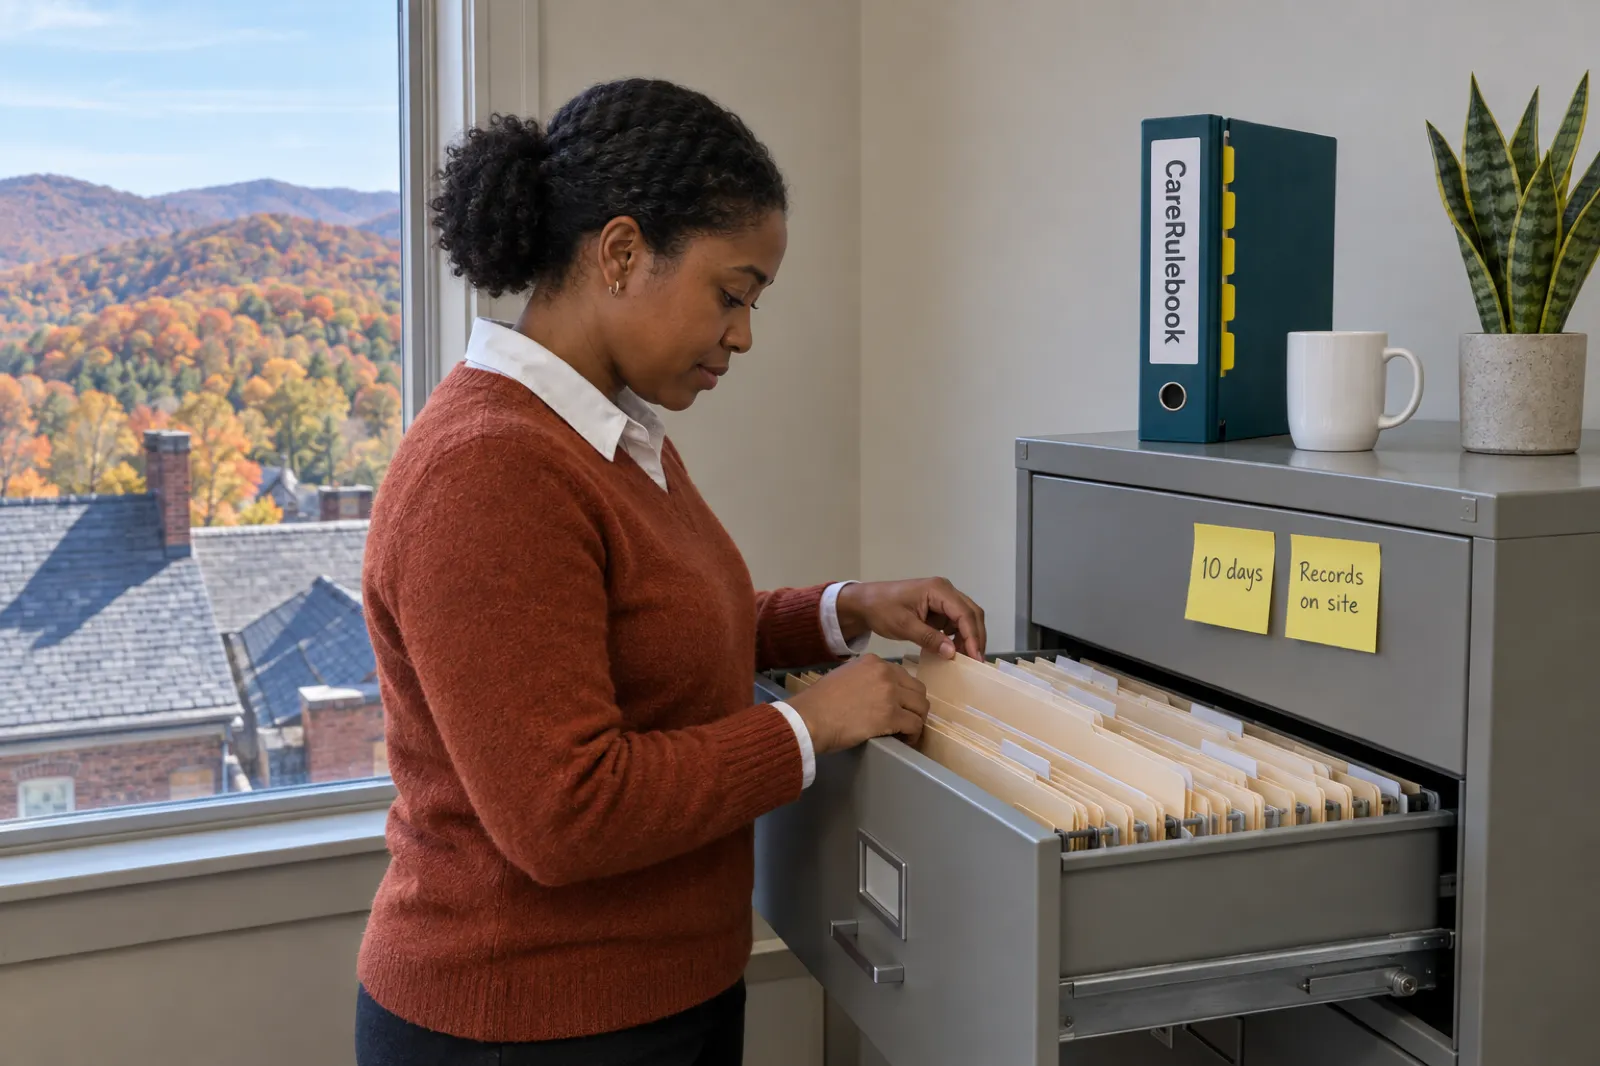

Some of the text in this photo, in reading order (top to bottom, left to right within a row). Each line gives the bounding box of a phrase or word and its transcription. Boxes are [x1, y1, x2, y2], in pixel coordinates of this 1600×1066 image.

[1164, 160, 1186, 344] CareRulebook
[1202, 556, 1263, 592] 10 days
[1299, 561, 1364, 585] Records
[1300, 593, 1358, 613] on site
